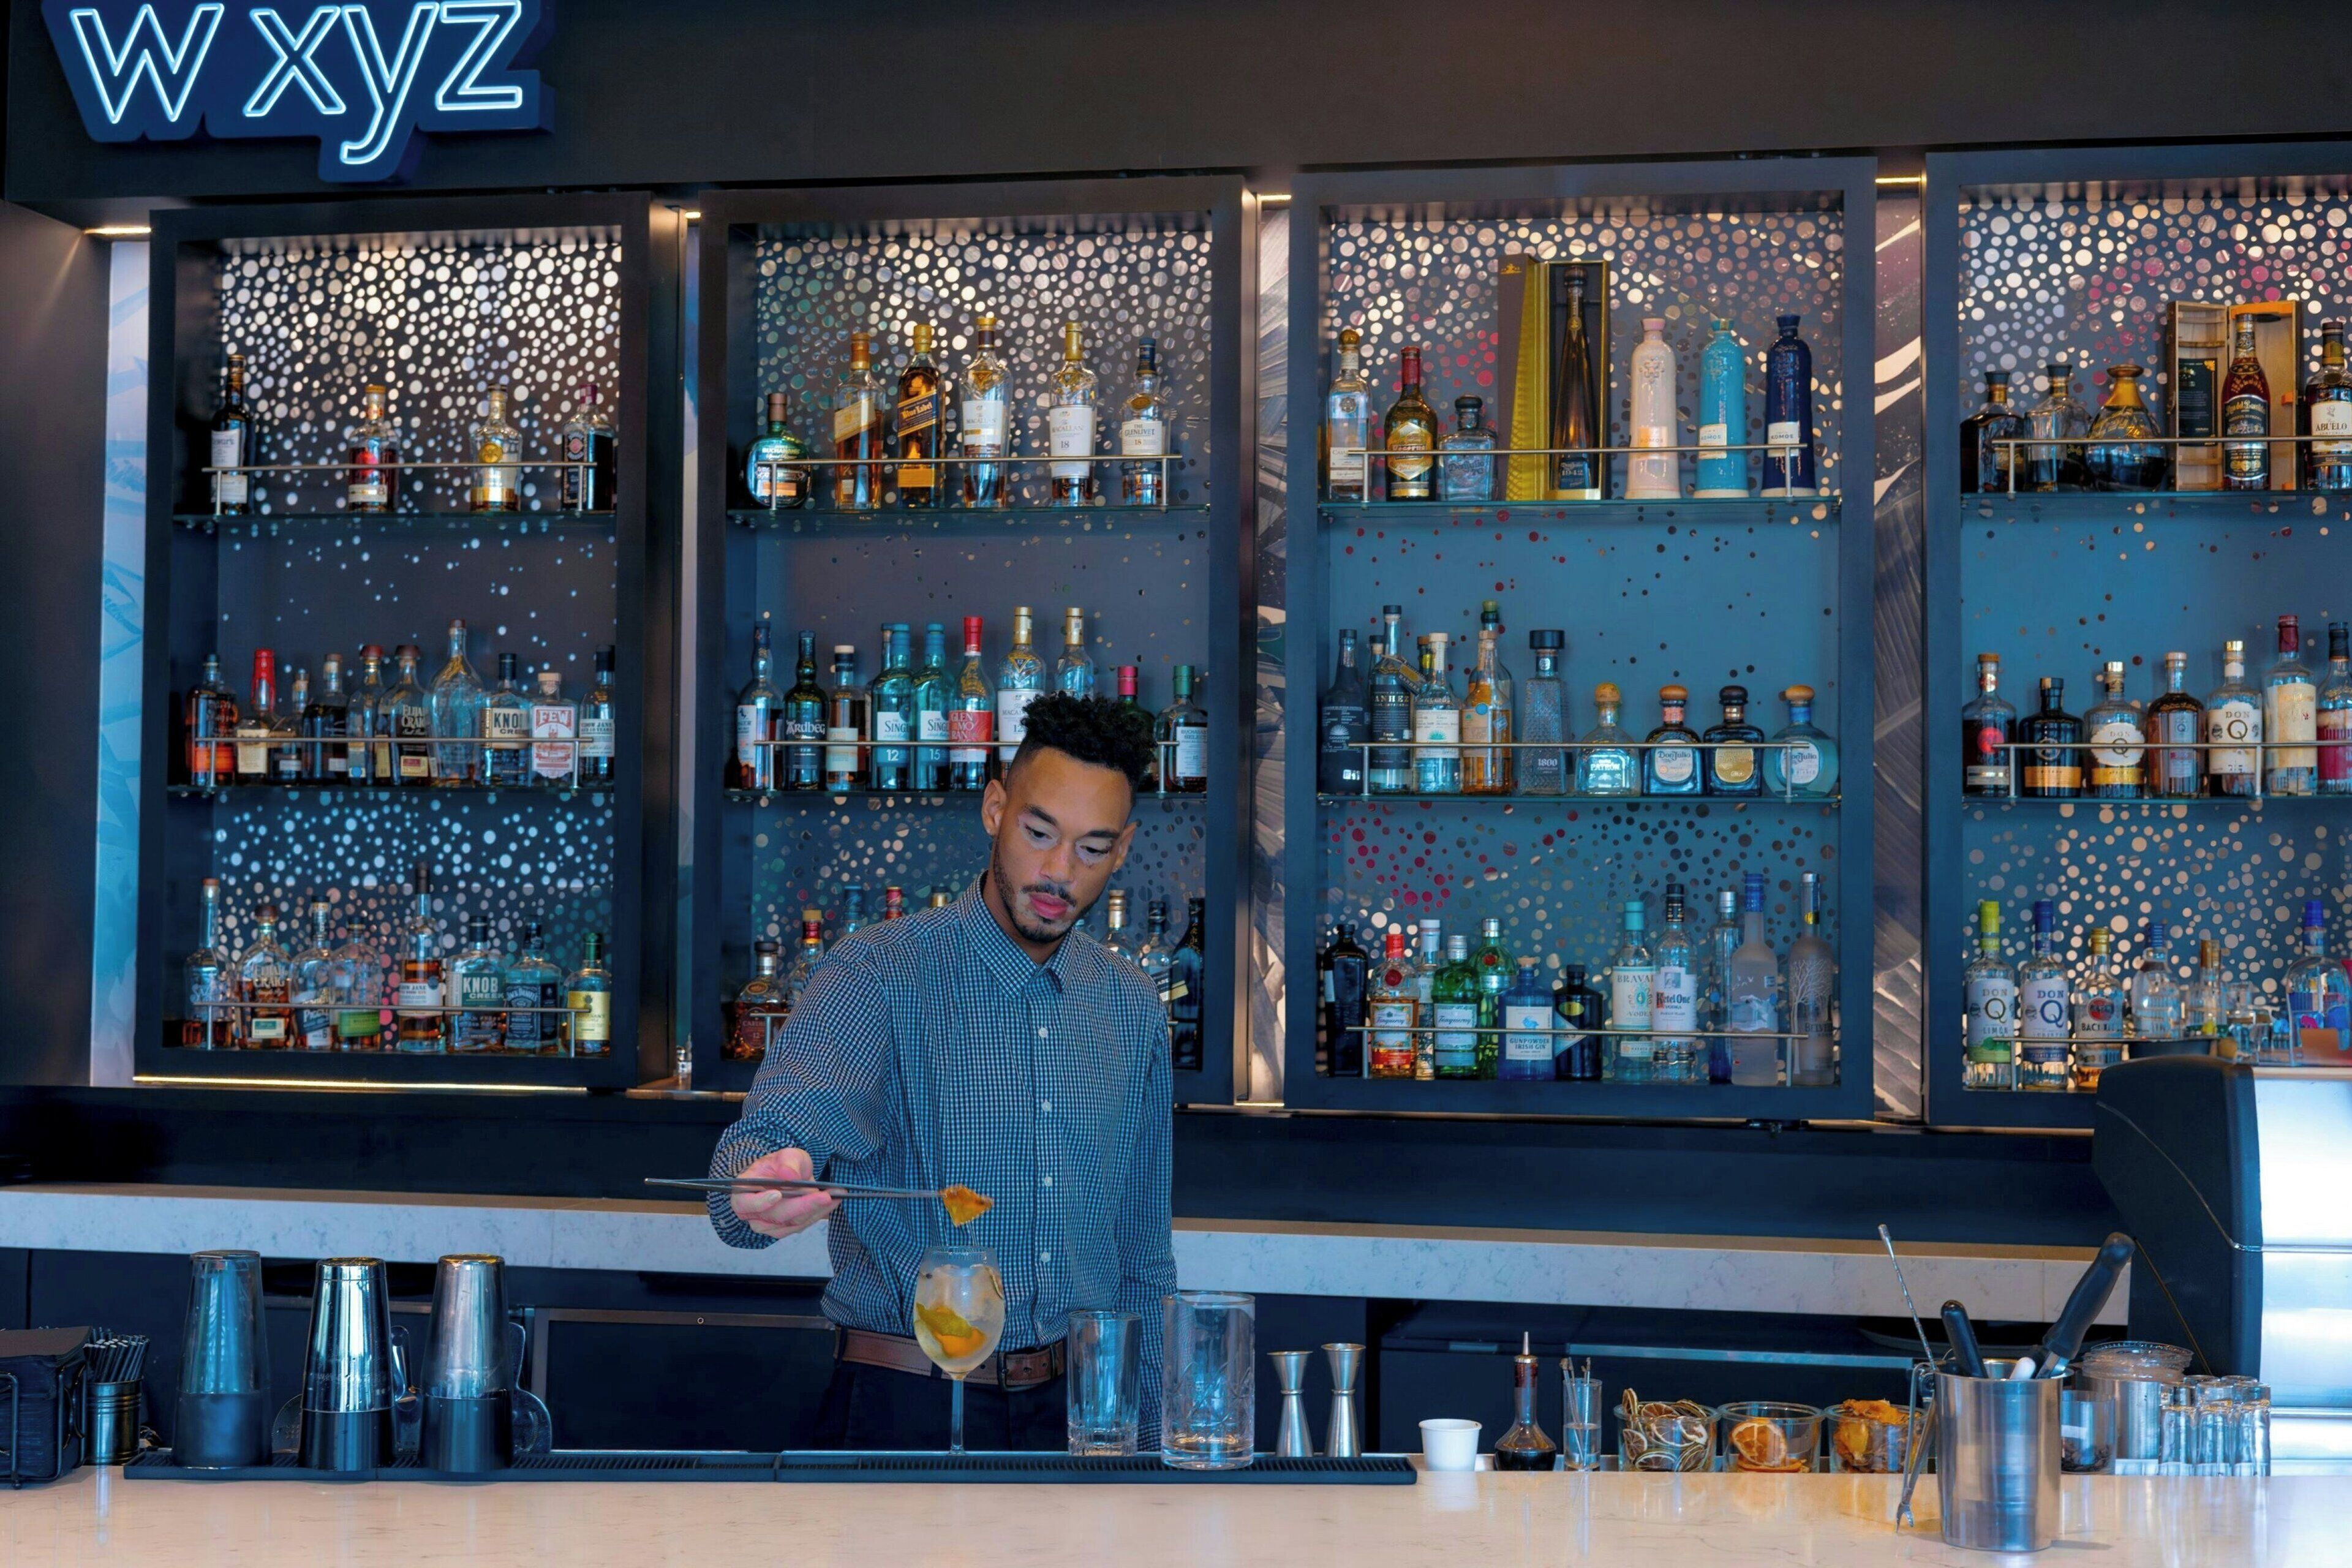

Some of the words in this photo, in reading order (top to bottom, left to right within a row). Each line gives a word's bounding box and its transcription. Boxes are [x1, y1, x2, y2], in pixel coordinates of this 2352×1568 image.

[244, 0, 524, 165] xyz
[2316, 422, 2347, 431] ABUELO
[494, 712, 521, 728] KNO
[540, 710, 568, 723] FEW
[950, 712, 973, 722] GLEN
[2227, 719, 2248, 742] Q
[2112, 737, 2128, 758] Q
[886, 748, 899, 761] 12
[929, 748, 941, 761] 15
[463, 976, 499, 993] KNOB
[1656, 992, 1676, 1004] Ketel
[1676, 993, 1691, 1004] One
[2037, 990, 2064, 998] DON
[1985, 997, 2007, 1023] Q
[2040, 1000, 2064, 1028] Q
[1376, 1017, 1405, 1025] Tanqueray
[1439, 1016, 1471, 1025] Tanqueray
